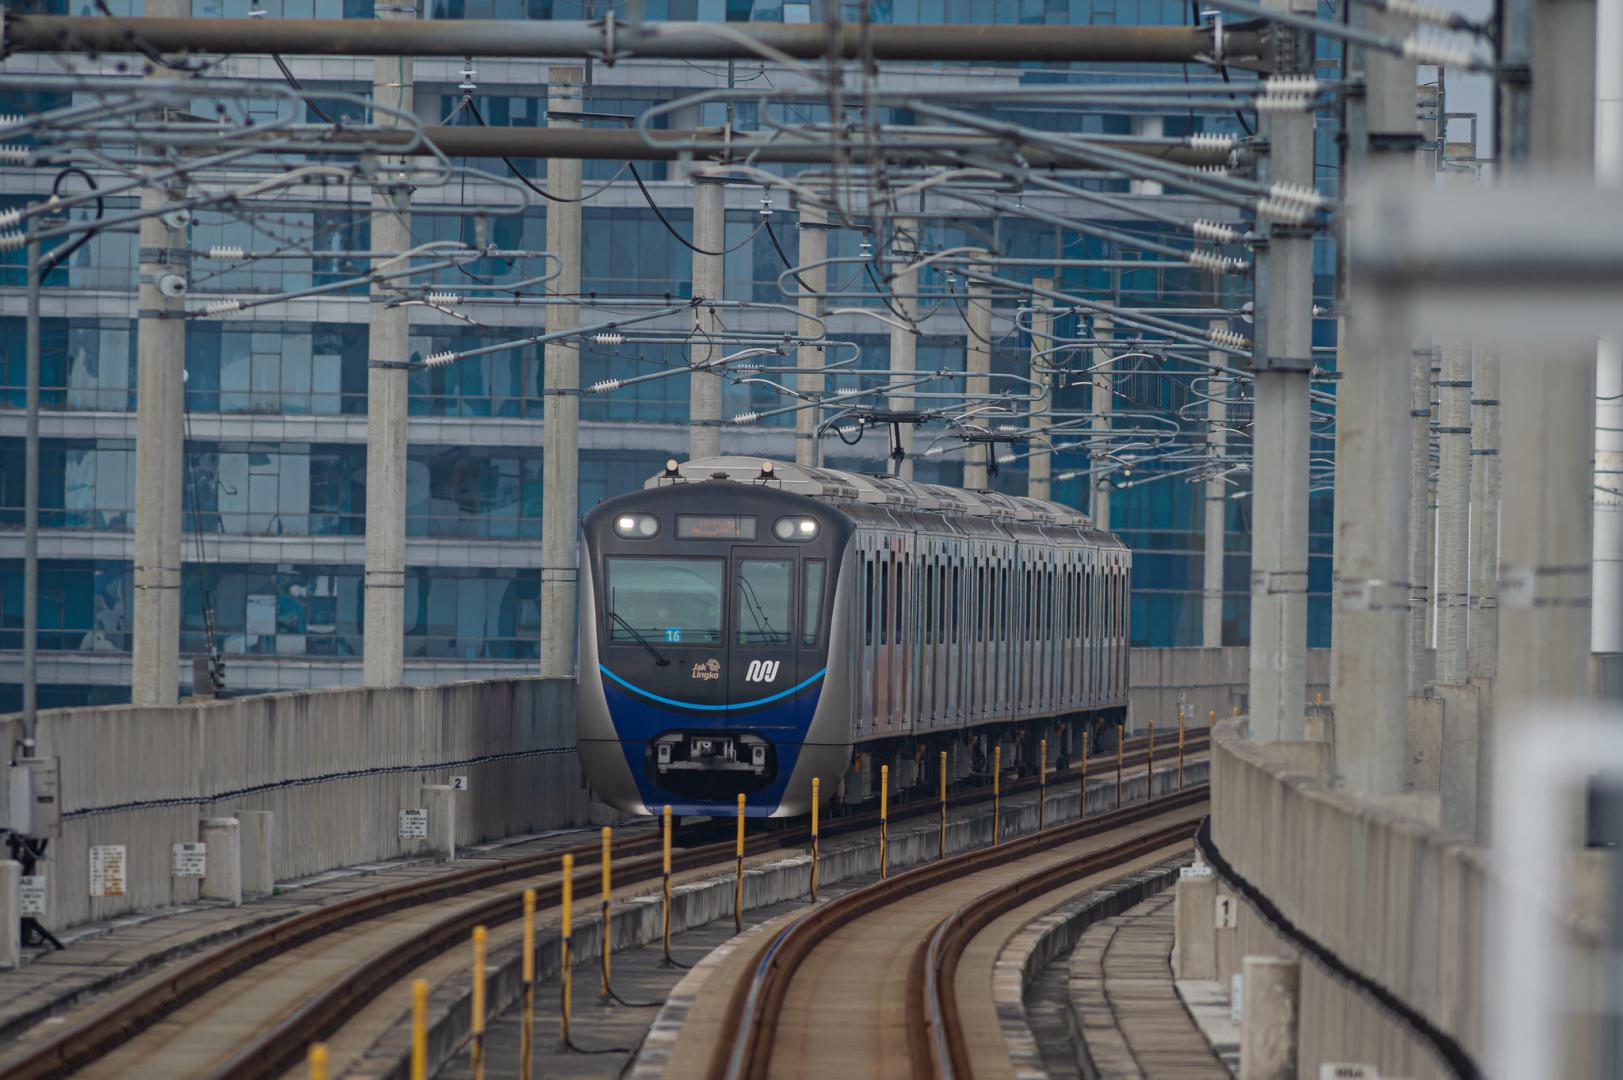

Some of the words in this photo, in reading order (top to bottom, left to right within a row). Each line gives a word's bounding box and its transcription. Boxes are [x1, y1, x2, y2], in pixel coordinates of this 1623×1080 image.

[666, 630, 680, 641] 16
[692, 663, 707, 671] Jak
[692, 671, 719, 680] Lingko
[455, 778, 461, 788] 2
[1222, 899, 1229, 915] 1
